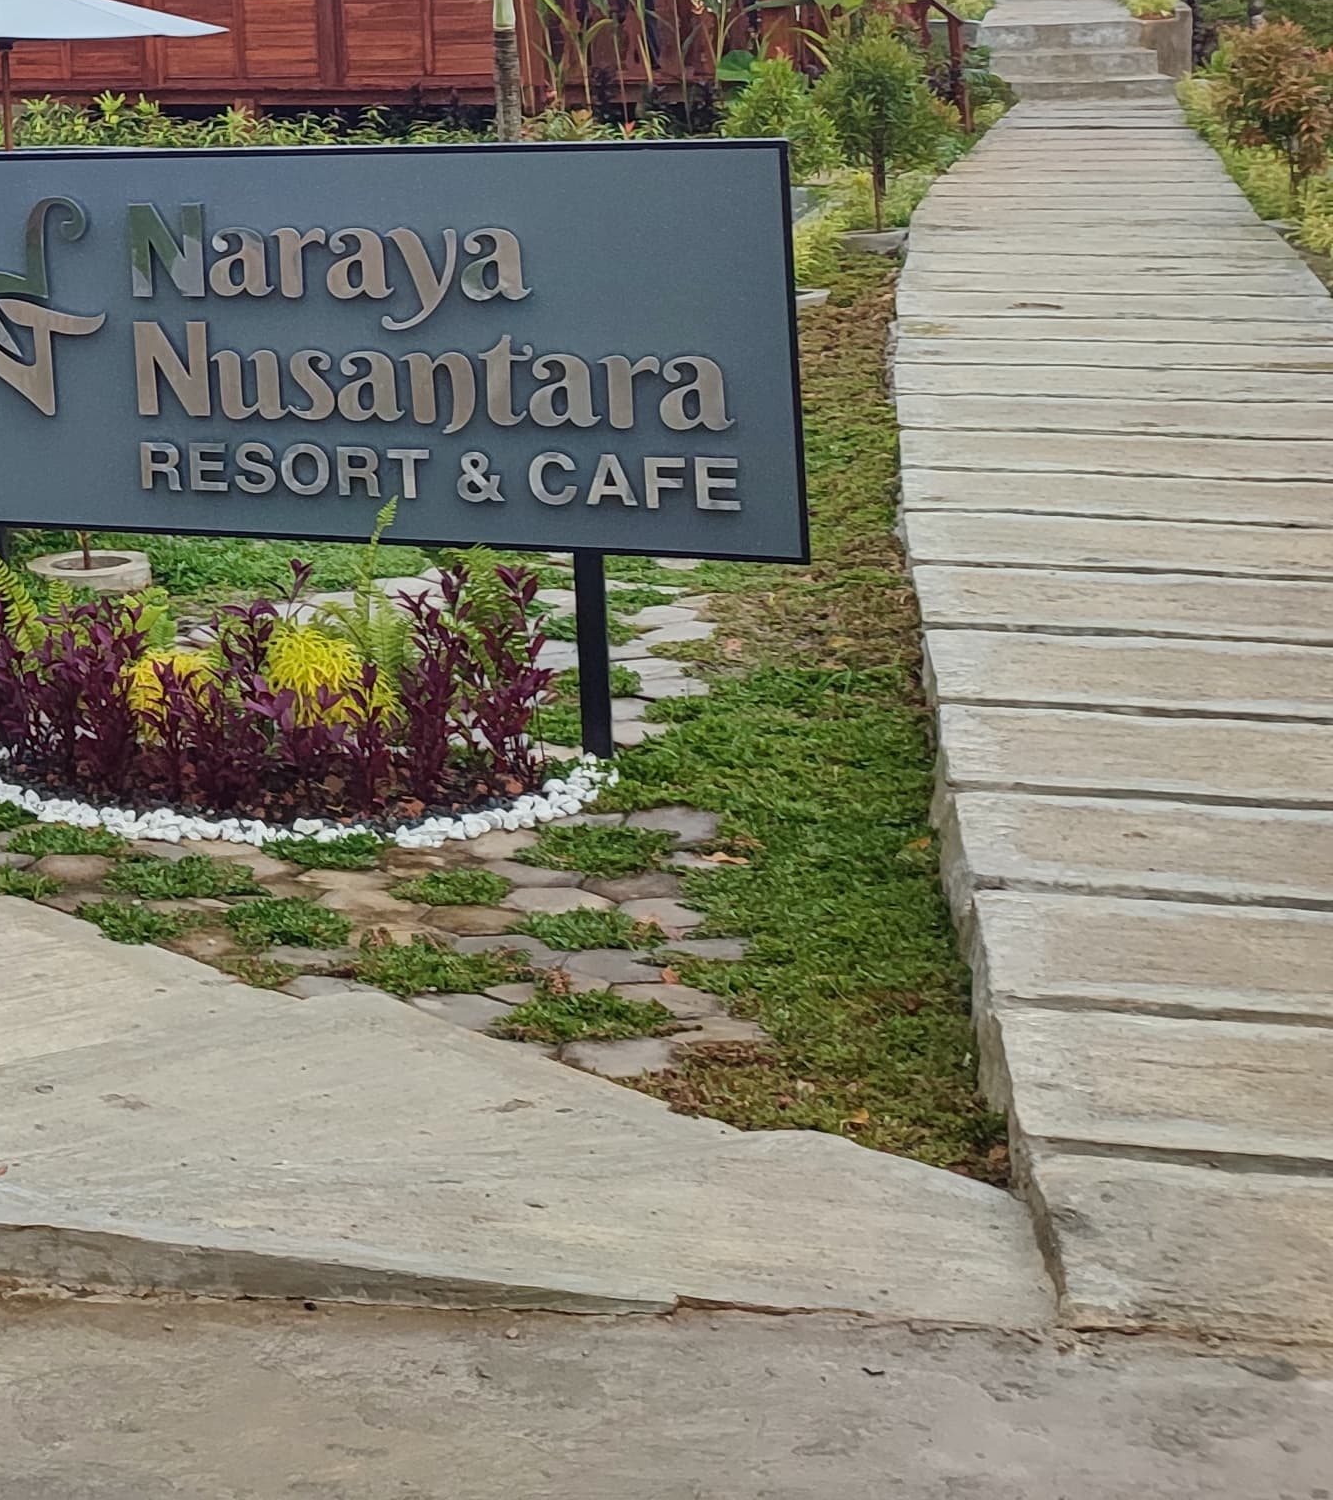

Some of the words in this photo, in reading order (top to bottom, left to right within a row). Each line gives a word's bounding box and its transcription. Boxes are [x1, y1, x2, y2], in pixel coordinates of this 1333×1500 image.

[127, 201, 532, 331] Naraya
[132, 320, 735, 435] Nusantara
[139, 441, 430, 501] RESORT
[457, 450, 504, 503] &
[528, 450, 741, 512] CAFE
